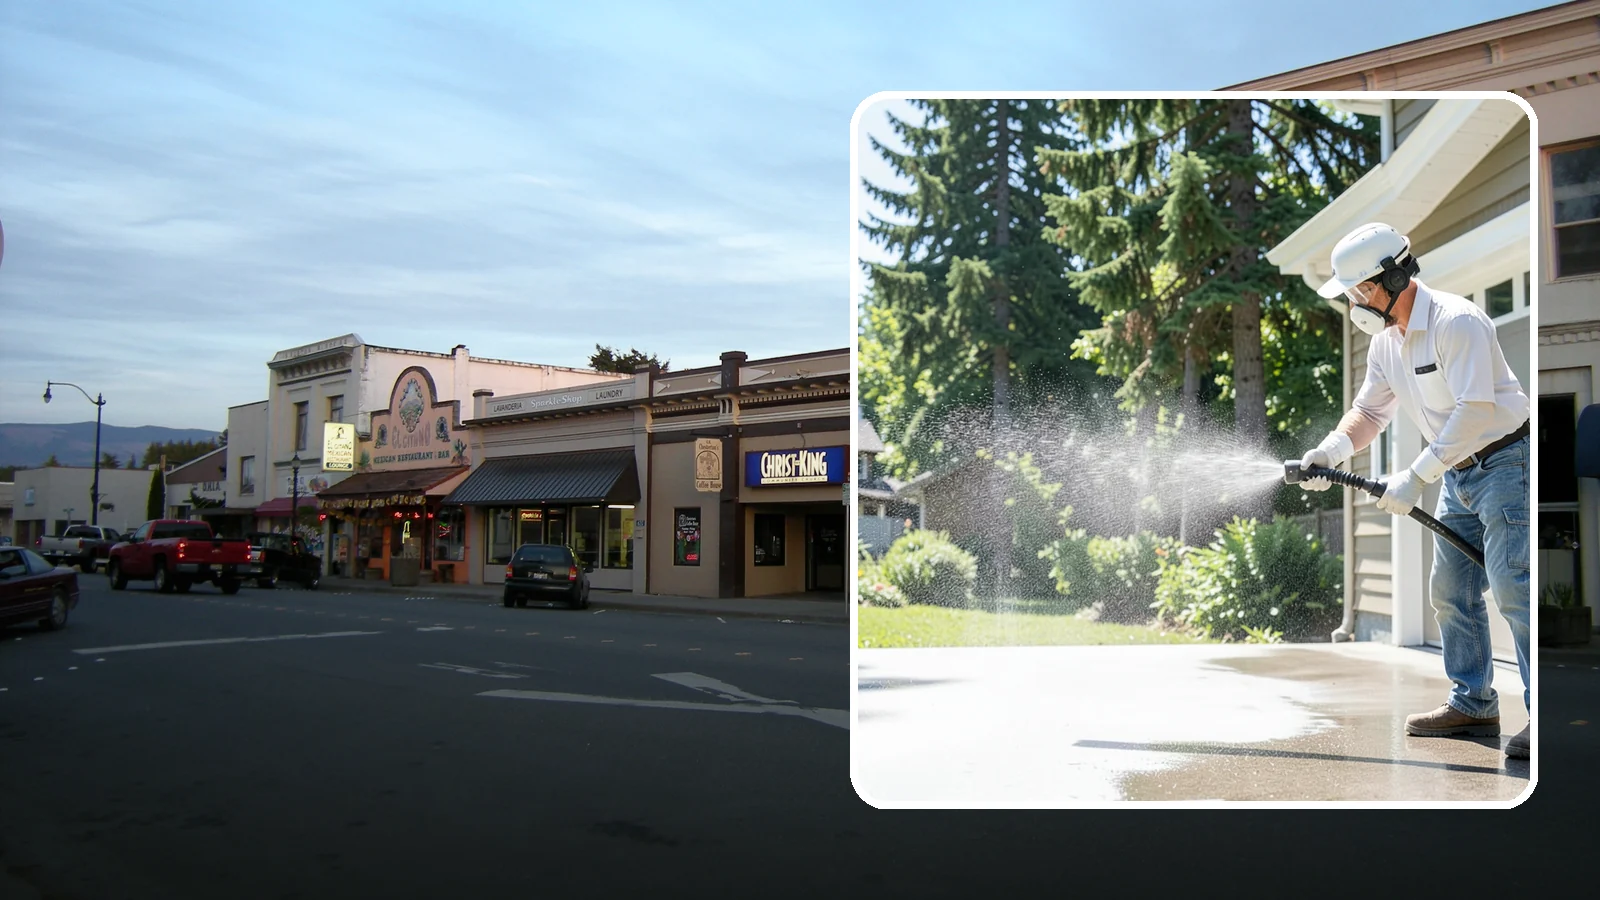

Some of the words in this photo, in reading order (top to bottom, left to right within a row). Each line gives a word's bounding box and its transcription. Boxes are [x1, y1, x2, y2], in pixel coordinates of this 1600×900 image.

[560, 394, 582, 404] Shop
[595, 389, 623, 400] LAUNDRY
[493, 402, 522, 413] LAVANDERIA
[397, 451, 433, 463] RESTAURANT
[438, 450, 450, 459] BAR
[761, 452, 797, 478] CHRIST
[799, 450, 828, 476] KING
